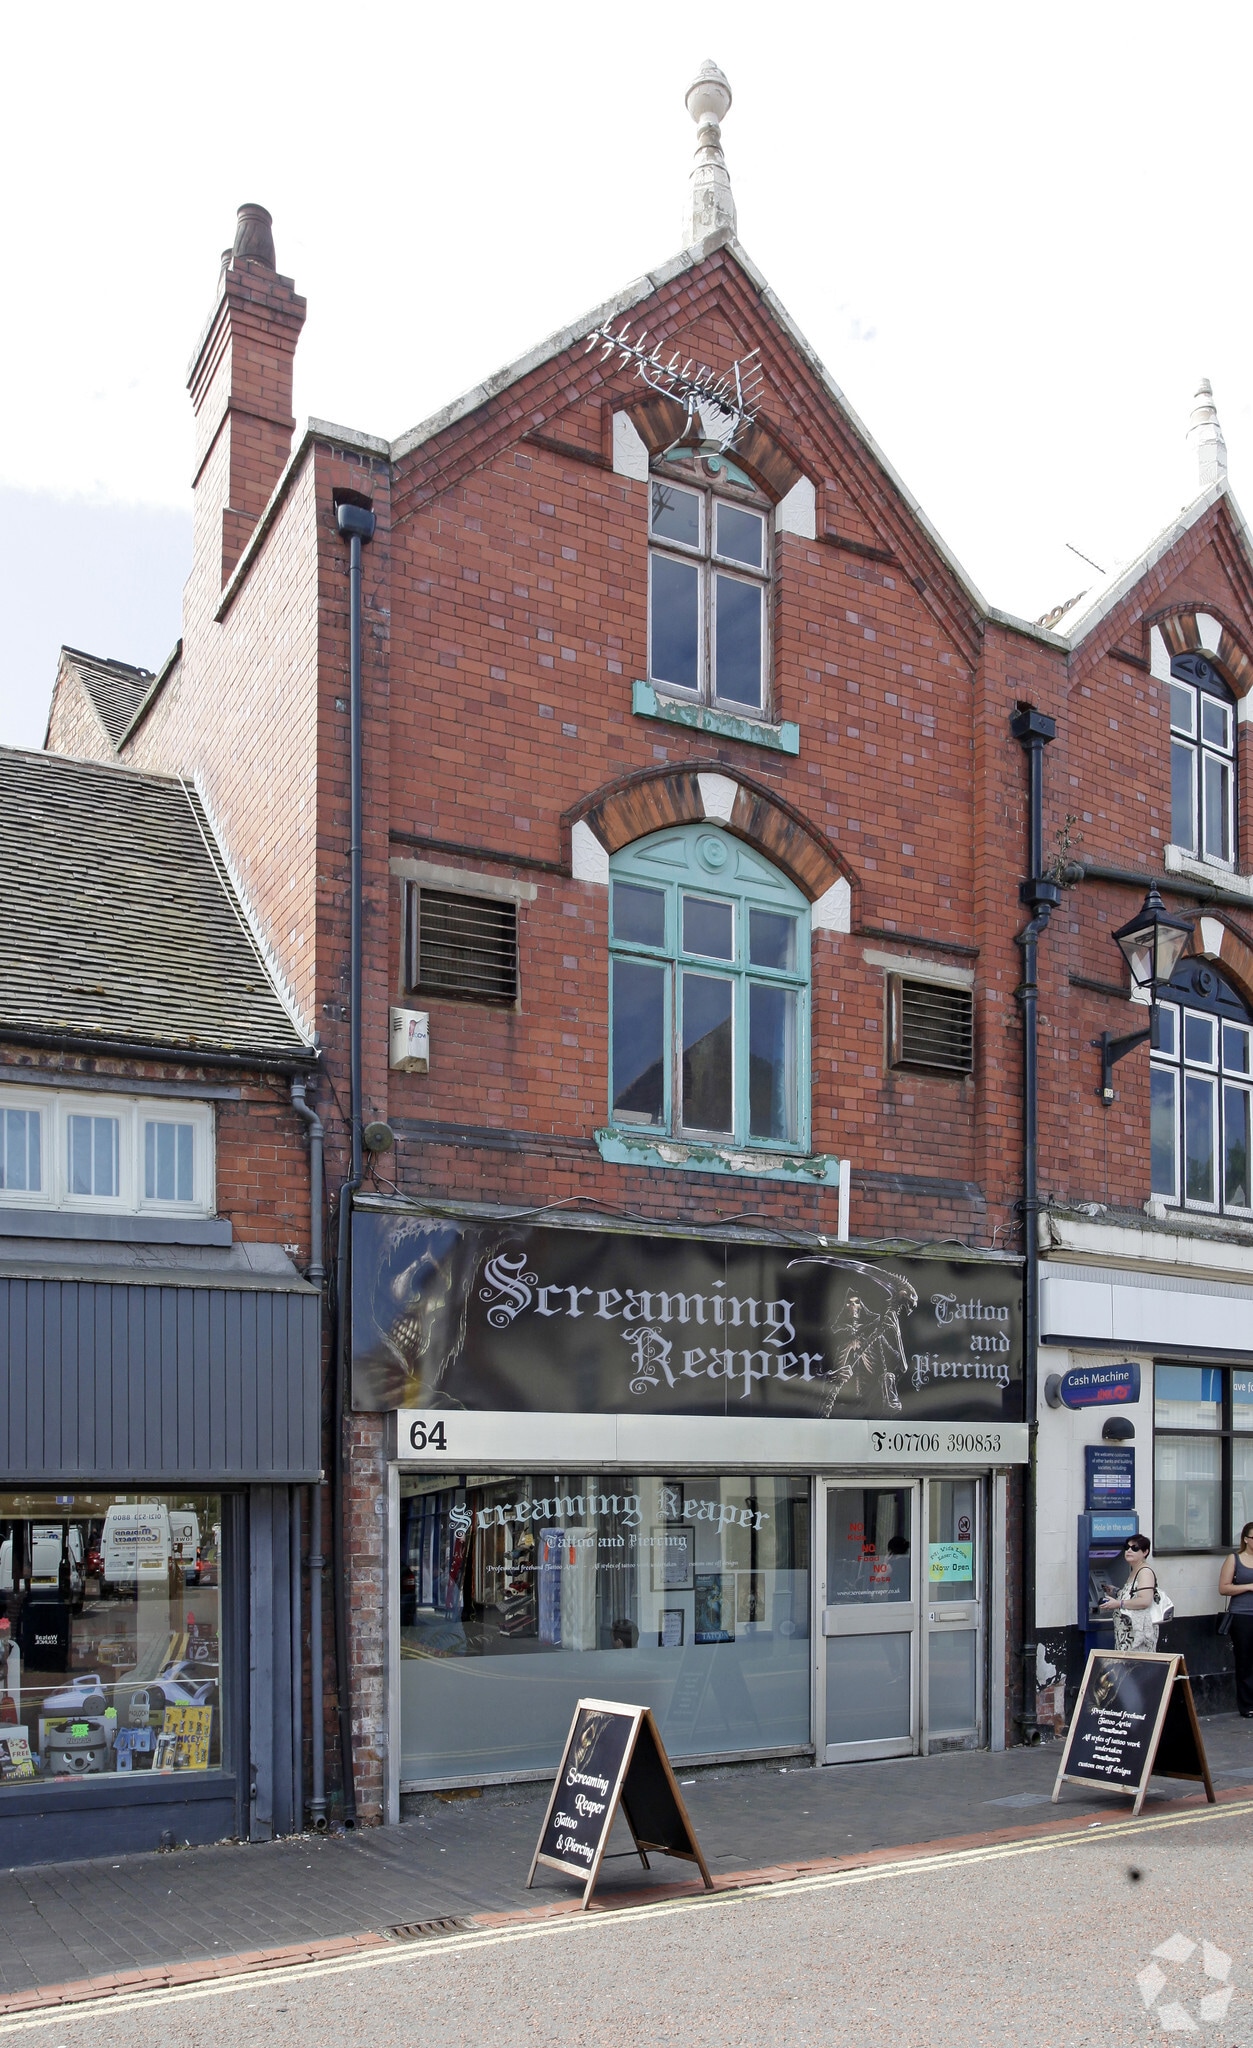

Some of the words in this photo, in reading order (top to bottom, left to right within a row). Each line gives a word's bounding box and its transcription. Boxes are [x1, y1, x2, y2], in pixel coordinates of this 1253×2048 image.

[479, 1252, 796, 1348] Screaming
[930, 1292, 1009, 1328] Tattoo
[970, 1331, 1010, 1352] and
[620, 1327, 823, 1399] Reaper
[911, 1352, 1010, 1391] Piercing
[1068, 1374, 1089, 1386] Cash
[1091, 1371, 1129, 1384] Machine
[408, 1419, 448, 1451] 64
[947, 1433, 1001, 1452] 390853
[448, 1484, 643, 1538] Screaming
[655, 1486, 770, 1534] Reaper
[849, 1523, 864, 1532] NO
[1113, 1522, 1121, 1531] the
[546, 1534, 595, 1549] Tattoo
[598, 1534, 625, 1548] and
[628, 1533, 688, 1551] Piercing
[862, 1544, 876, 1552] NO
[486, 1564, 520, 1573] Professional
[520, 1563, 544, 1572] freehand
[874, 1564, 888, 1573] NO
[1091, 1707, 1123, 1717] Professional
[1121, 1711, 1146, 1720] freehand
[1115, 1720, 1132, 1728] Artist
[1082, 1734, 1092, 1742] All
[1091, 1735, 1104, 1744] styles
[1105, 1737, 1111, 1745] of
[1095, 1746, 1122, 1754] undertaken
[1105, 1765, 1114, 1774] off
[1113, 1766, 1132, 1776] designs
[566, 1768, 610, 1796] Screaming
[575, 1794, 606, 1818] Reaper
[554, 1811, 578, 1830] Tattoo
[556, 1834, 564, 1849] &
[563, 1836, 595, 1863] Piercing
